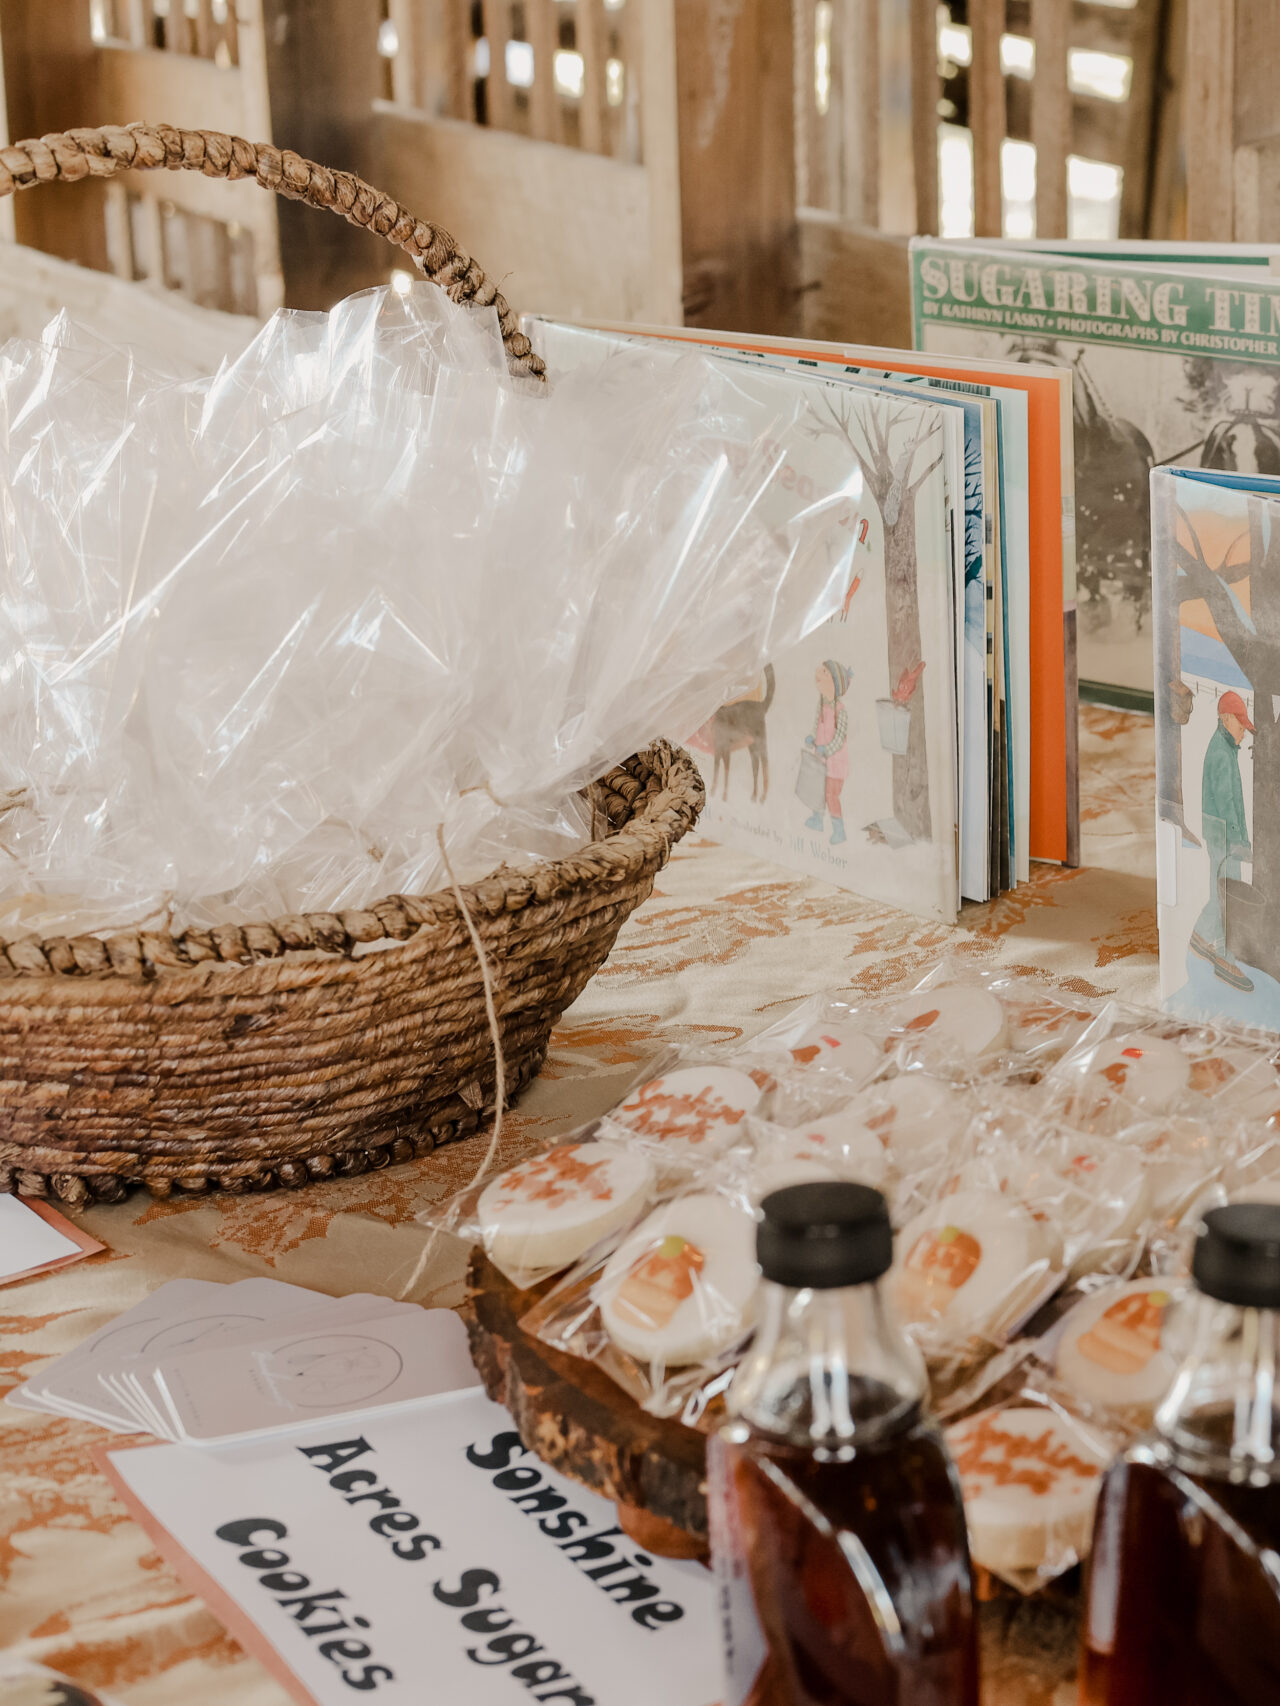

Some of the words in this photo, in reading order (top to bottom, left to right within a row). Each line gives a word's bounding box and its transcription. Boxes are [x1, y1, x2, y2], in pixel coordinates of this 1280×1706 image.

[920, 256, 1190, 328] SUGARING
[922, 300, 940, 316] BY
[941, 302, 1003, 324] KATHRYN
[1004, 310, 1046, 329] LASKY
[1056, 316, 1159, 342] PHOTOGRAPHS
[1160, 328, 1180, 345] BY
[1180, 331, 1278, 357] CHRISTOPHER
[214, 1516, 395, 1693] Cookies
[295, 1434, 441, 1562] Acres
[431, 1568, 596, 1706] Sugar
[463, 1430, 686, 1632] Sonshine
